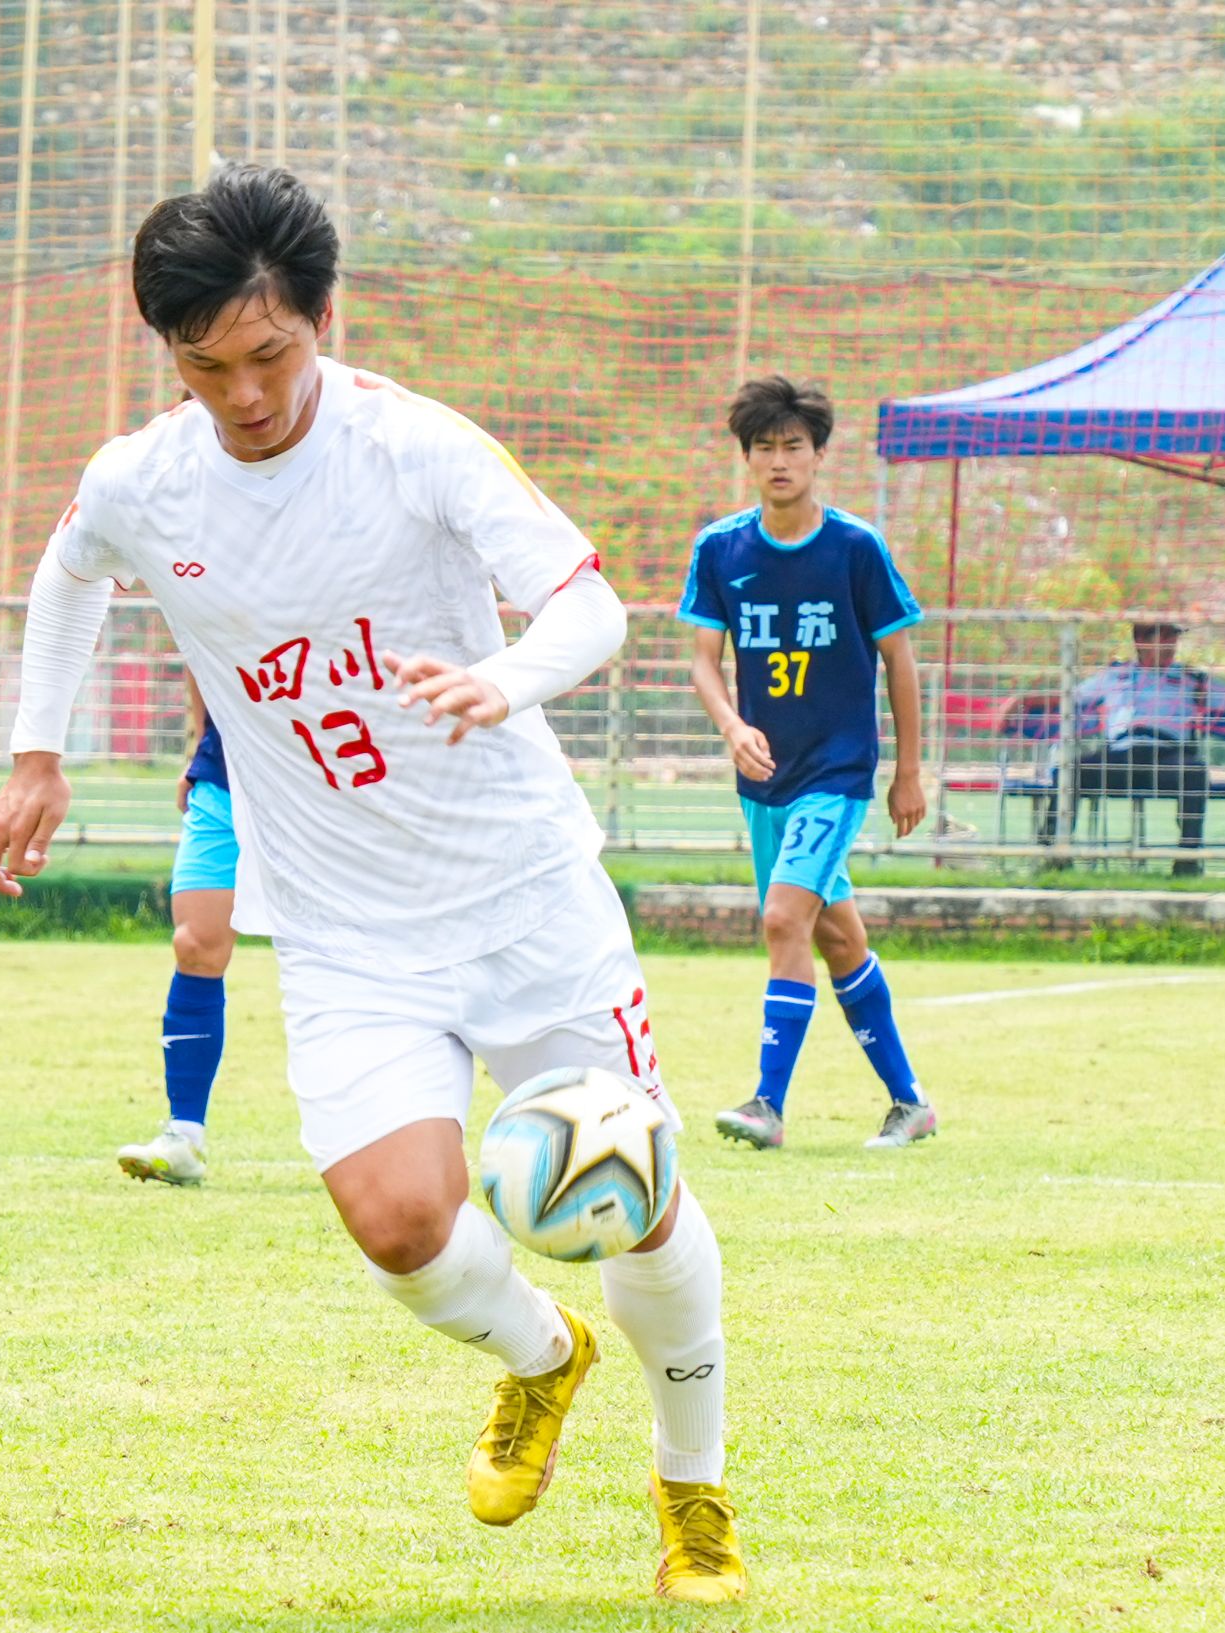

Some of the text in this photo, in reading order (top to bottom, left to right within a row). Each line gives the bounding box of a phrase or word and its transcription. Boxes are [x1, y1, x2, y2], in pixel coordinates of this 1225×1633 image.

[739, 601, 837, 649] 江苏
[236, 617, 384, 702] 四川
[767, 651, 810, 697] 37
[291, 710, 386, 790] 13
[785, 816, 836, 856] 37
